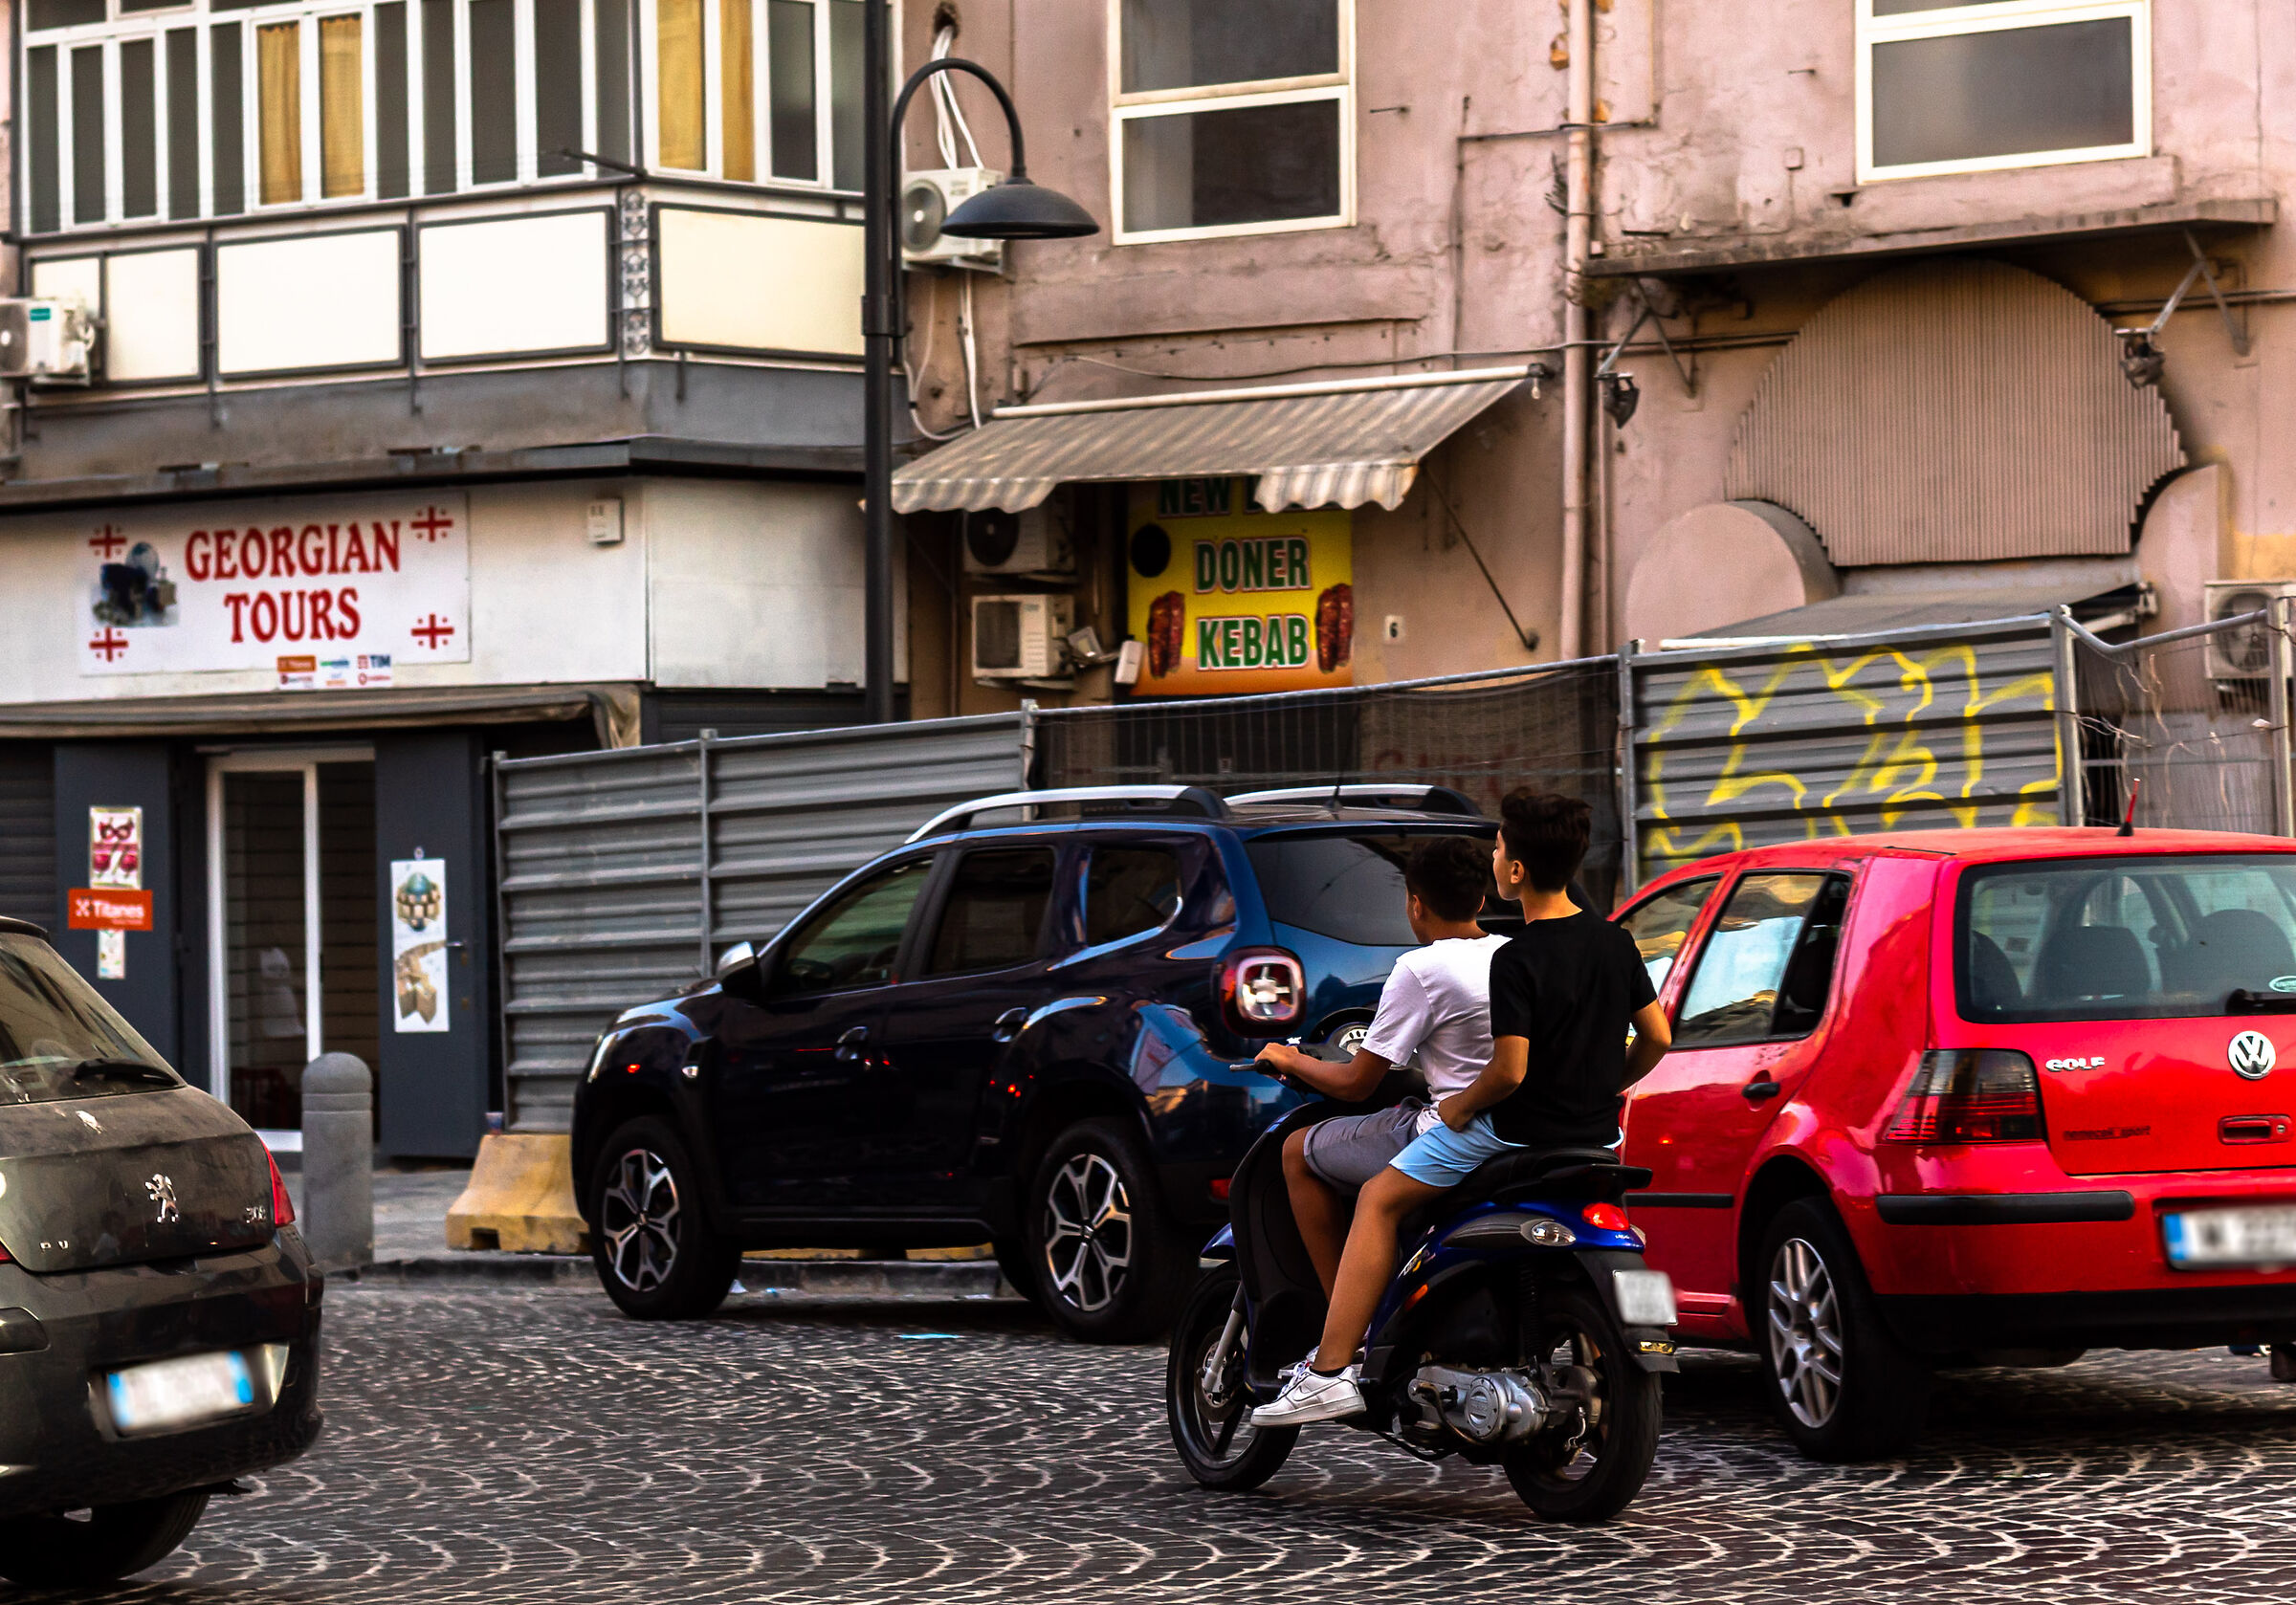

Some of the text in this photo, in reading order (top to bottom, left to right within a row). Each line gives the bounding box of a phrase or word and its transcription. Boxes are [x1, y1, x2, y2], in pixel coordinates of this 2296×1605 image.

[1158, 477, 1231, 517] NEW
[185, 520, 401, 582] GEORGIAN
[1195, 536, 1312, 593] DONER
[224, 587, 361, 644] TOURS
[1389, 622, 1398, 638] 6
[369, 654, 391, 669] TIM
[1196, 614, 1310, 671] KEBAB
[93, 900, 144, 918] Titanes
[2045, 1056, 2106, 1072] GOLF
